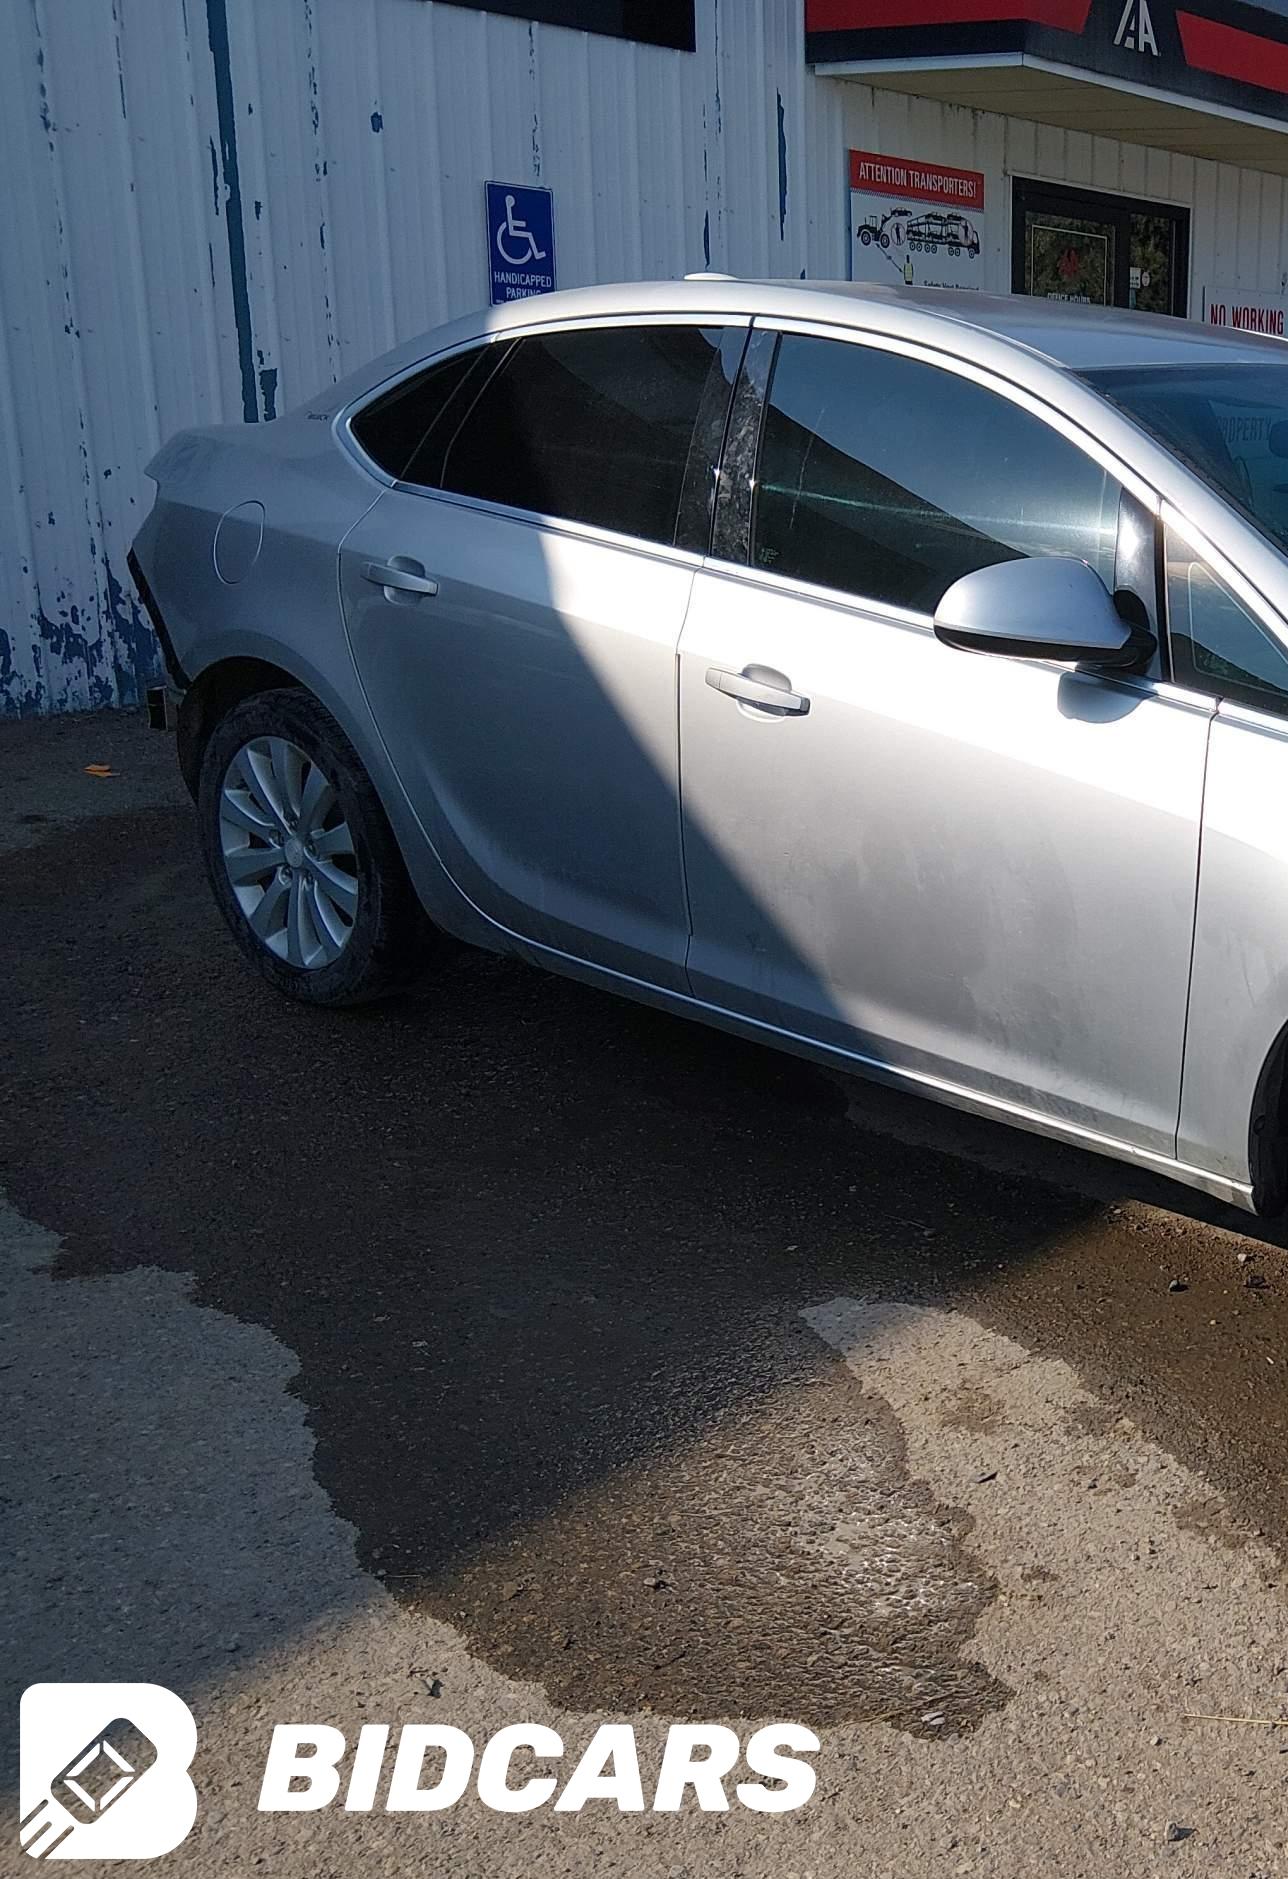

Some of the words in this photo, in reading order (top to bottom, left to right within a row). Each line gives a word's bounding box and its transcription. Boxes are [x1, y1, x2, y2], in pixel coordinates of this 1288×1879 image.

[859, 161, 907, 186] ATTENTION
[909, 170, 976, 198] TRANSPORTERS!
[494, 271, 552, 288] HANDICAPPED
[1210, 303, 1226, 326] NO
[1232, 306, 1284, 335] WORKING
